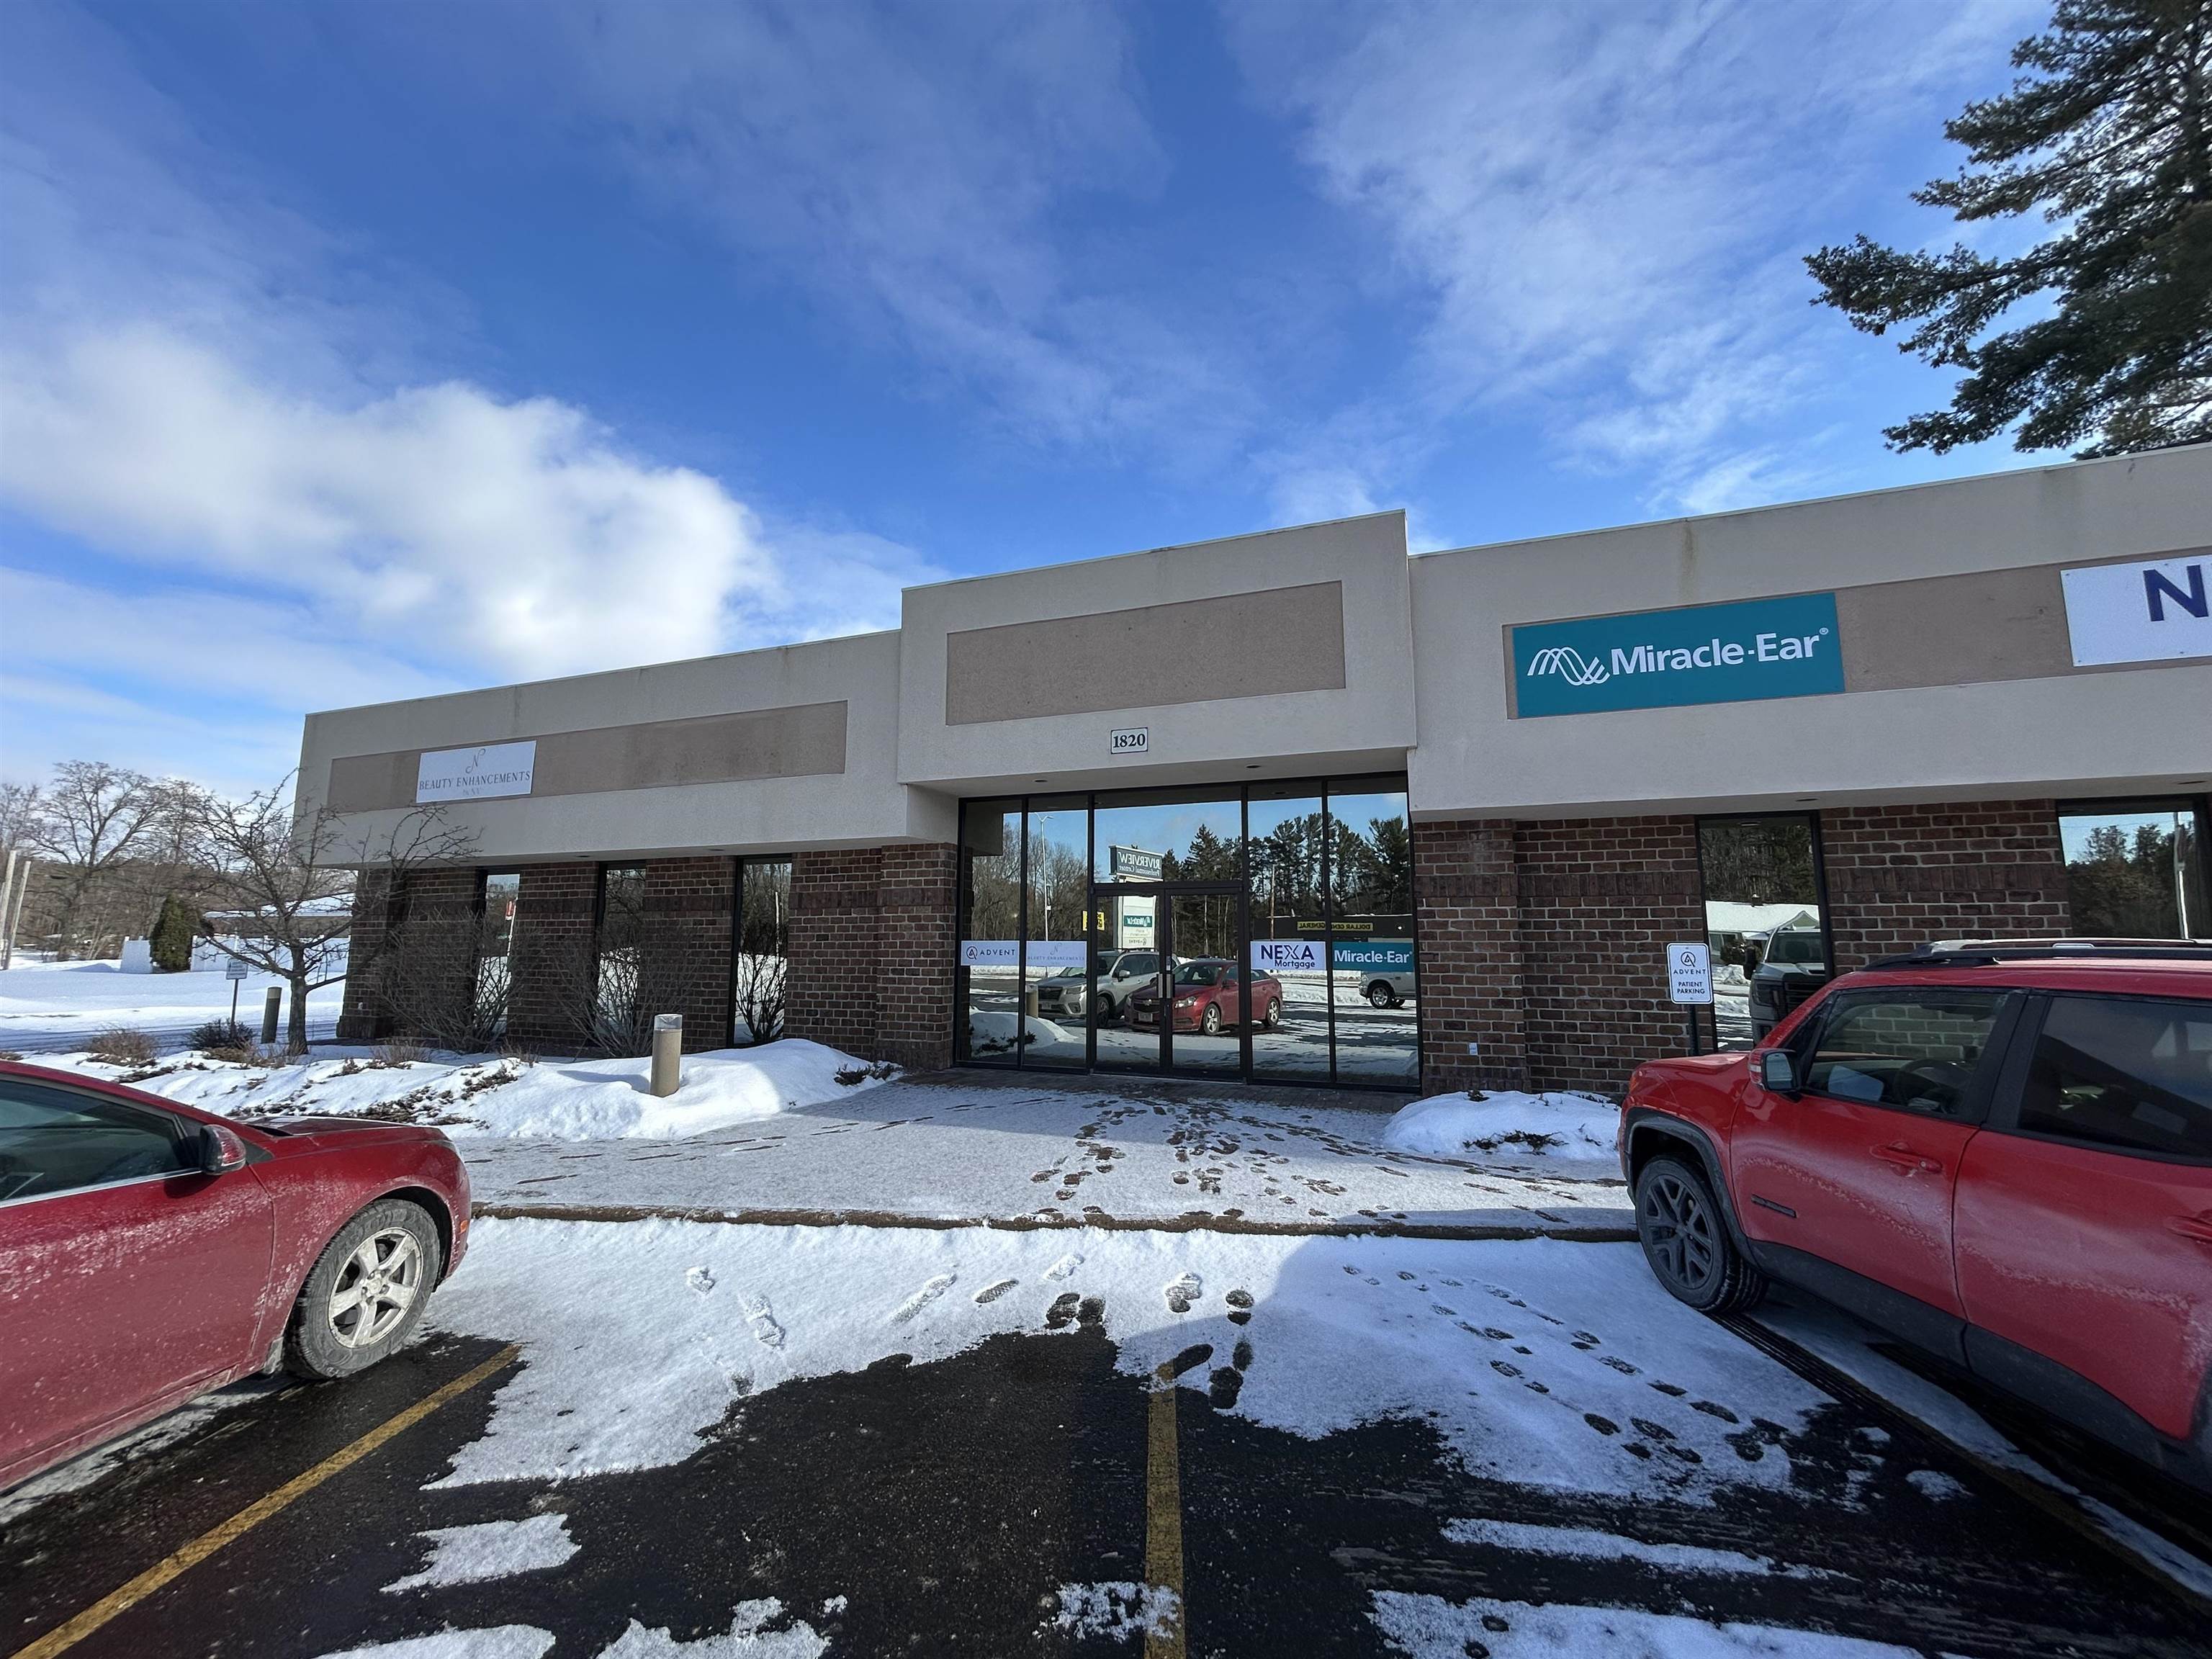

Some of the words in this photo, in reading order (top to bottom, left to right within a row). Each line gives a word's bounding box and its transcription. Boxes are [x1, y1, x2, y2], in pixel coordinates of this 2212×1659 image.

[1113, 734, 1146, 747] 1820
[419, 778, 453, 790] BEAUTY
[457, 771, 531, 787] ENHANCEMENTS
[1261, 945, 1314, 960] NEXA
[1274, 960, 1316, 969] Mortgage
